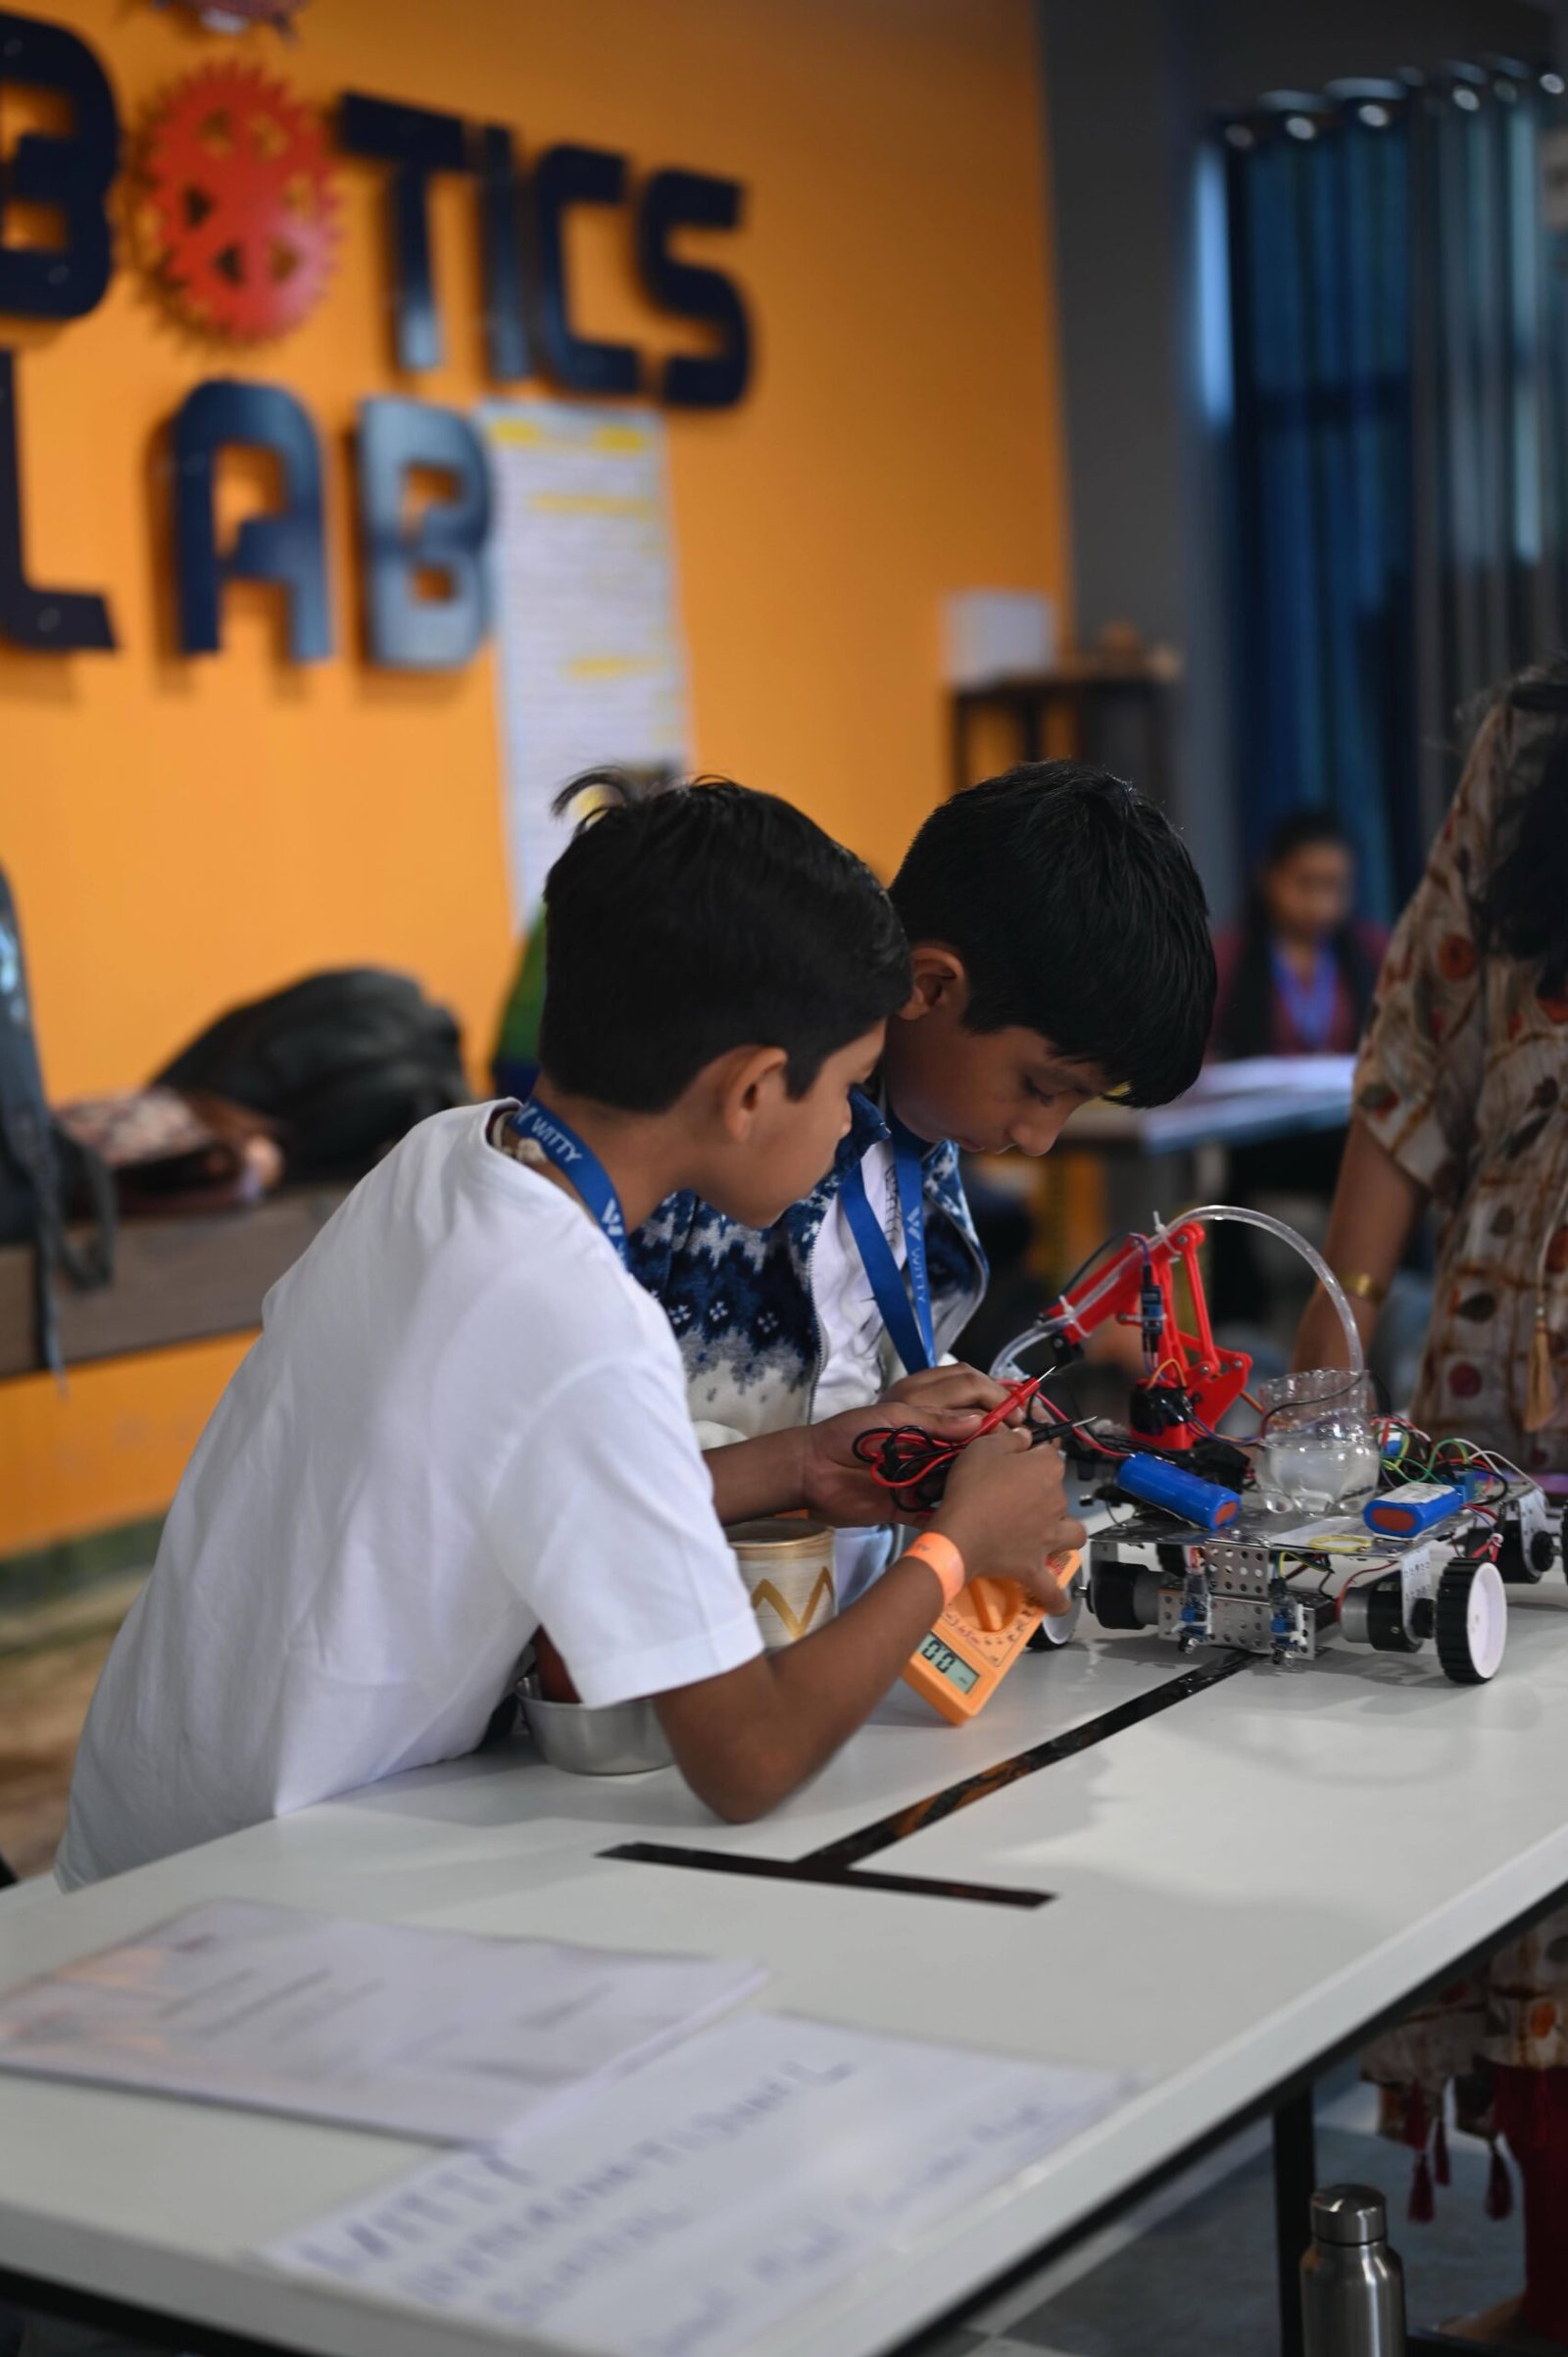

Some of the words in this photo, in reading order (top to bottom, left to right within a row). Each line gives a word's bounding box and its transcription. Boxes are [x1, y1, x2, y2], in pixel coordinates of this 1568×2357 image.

[0, 346, 494, 671] LAB
[530, 1115, 583, 1163] WITTY
[911, 1247, 927, 1304] WITTY
